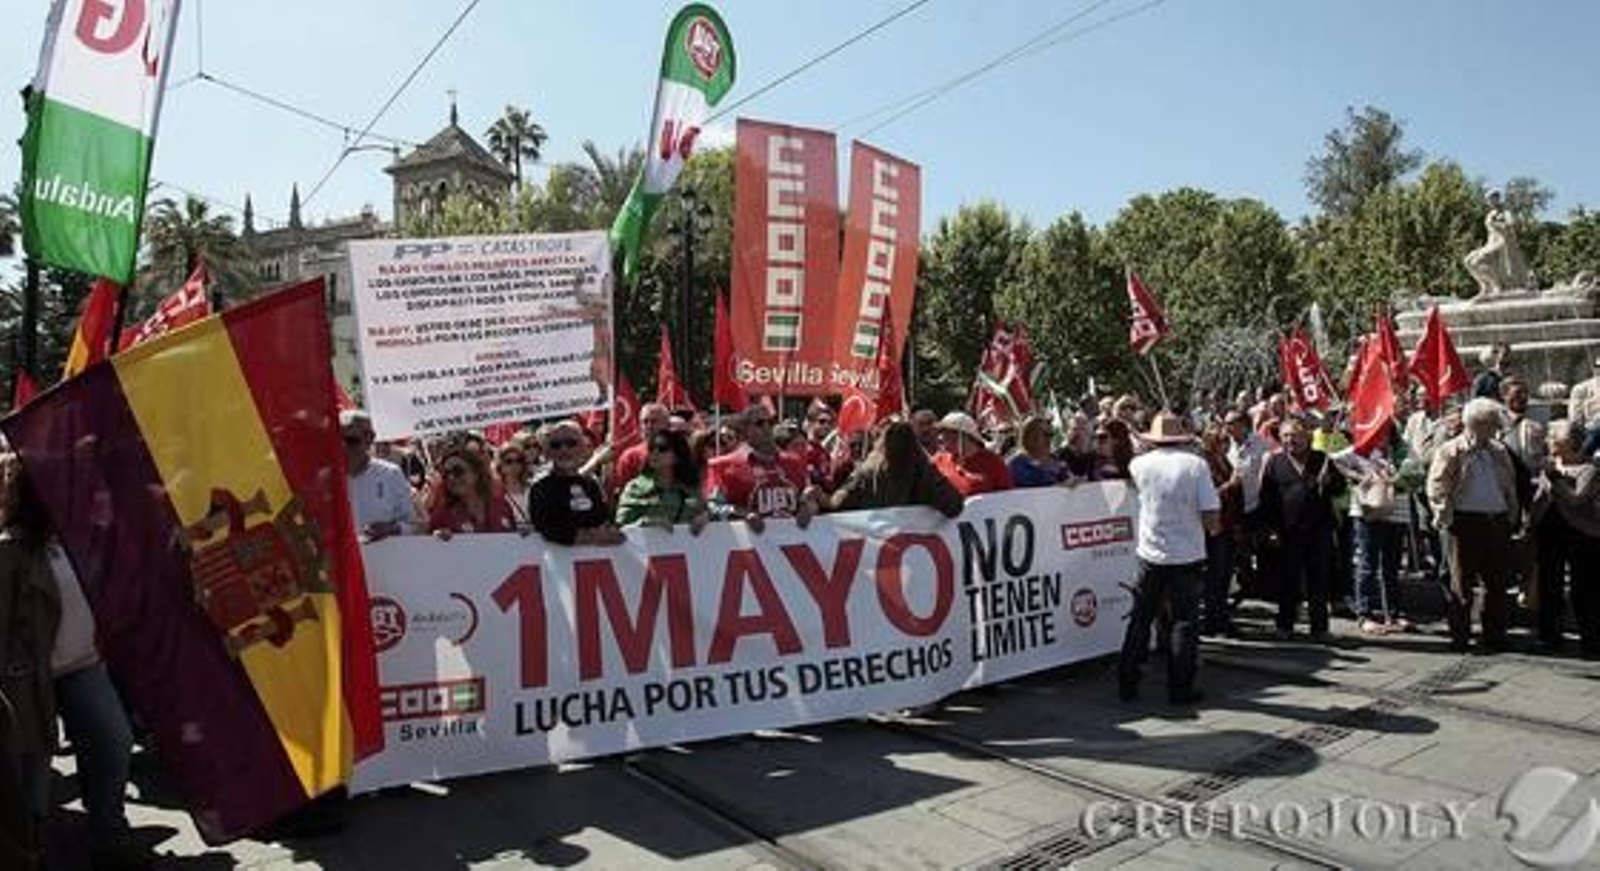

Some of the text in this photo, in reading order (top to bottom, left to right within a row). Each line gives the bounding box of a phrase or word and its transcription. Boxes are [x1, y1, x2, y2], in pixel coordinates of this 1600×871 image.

[766, 134, 806, 312] CCOO
[858, 158, 899, 320] CCOO
[736, 359, 823, 386] Sevilla
[959, 514, 1036, 586] NO
[1065, 524, 1115, 547] CCOO
[964, 572, 1063, 624] TIENEN
[970, 611, 1058, 664] LIMITE
[514, 640, 953, 736] LUCHA POR TUS DERECHOS
[399, 719, 478, 743] Sevilla
